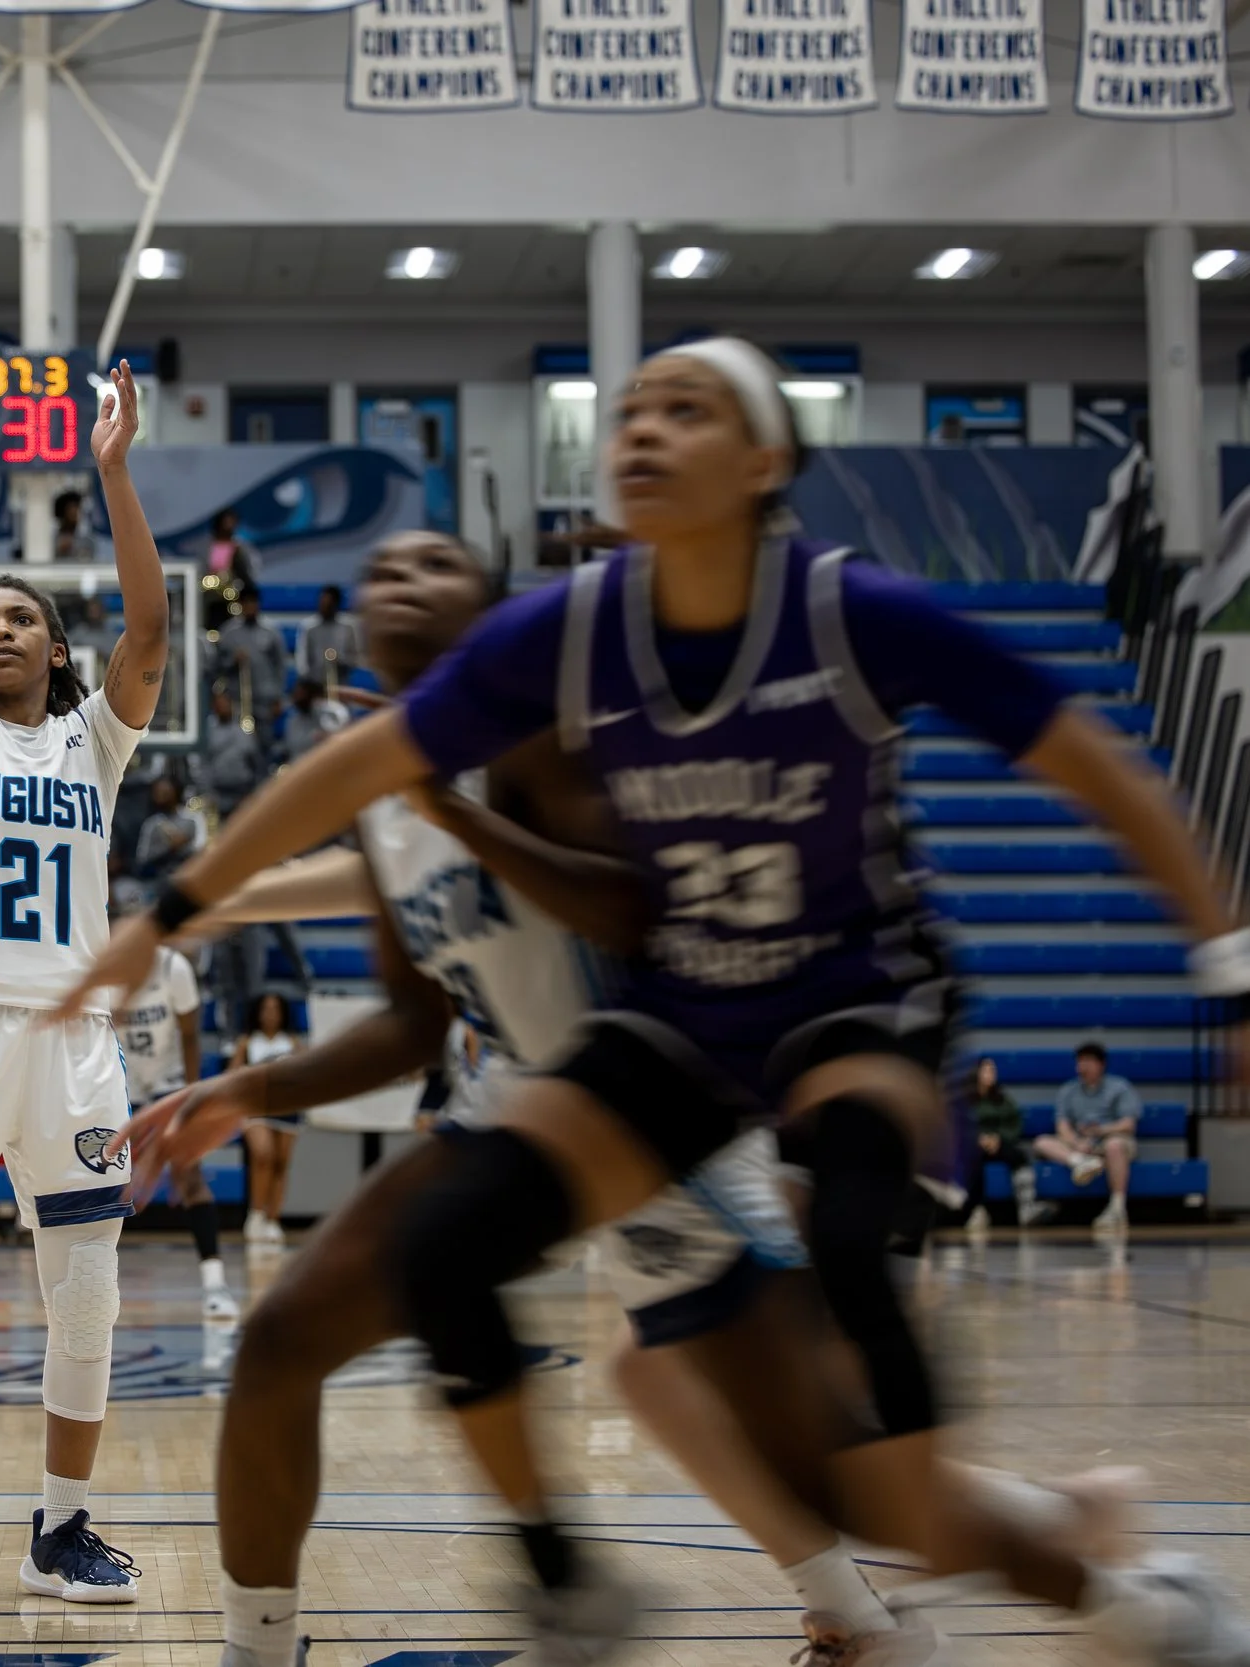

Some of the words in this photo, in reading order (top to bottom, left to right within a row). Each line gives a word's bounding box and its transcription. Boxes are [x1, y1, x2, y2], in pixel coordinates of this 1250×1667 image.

[362, 25, 502, 56] CONFERENCE
[545, 26, 685, 59] CONFERENCE
[728, 27, 865, 61] CONFERENCE
[910, 27, 1038, 61] CONFERENCE
[1089, 31, 1221, 65] CONFERENCE
[368, 67, 501, 99] CHAMPIONS
[552, 68, 681, 99] CHAMPIONS
[733, 68, 863, 101] CHAMPIONS
[914, 68, 1036, 101] CHAMPIONS
[1094, 74, 1220, 107] CHAMPIONS
[1, 396, 78, 463] 30
